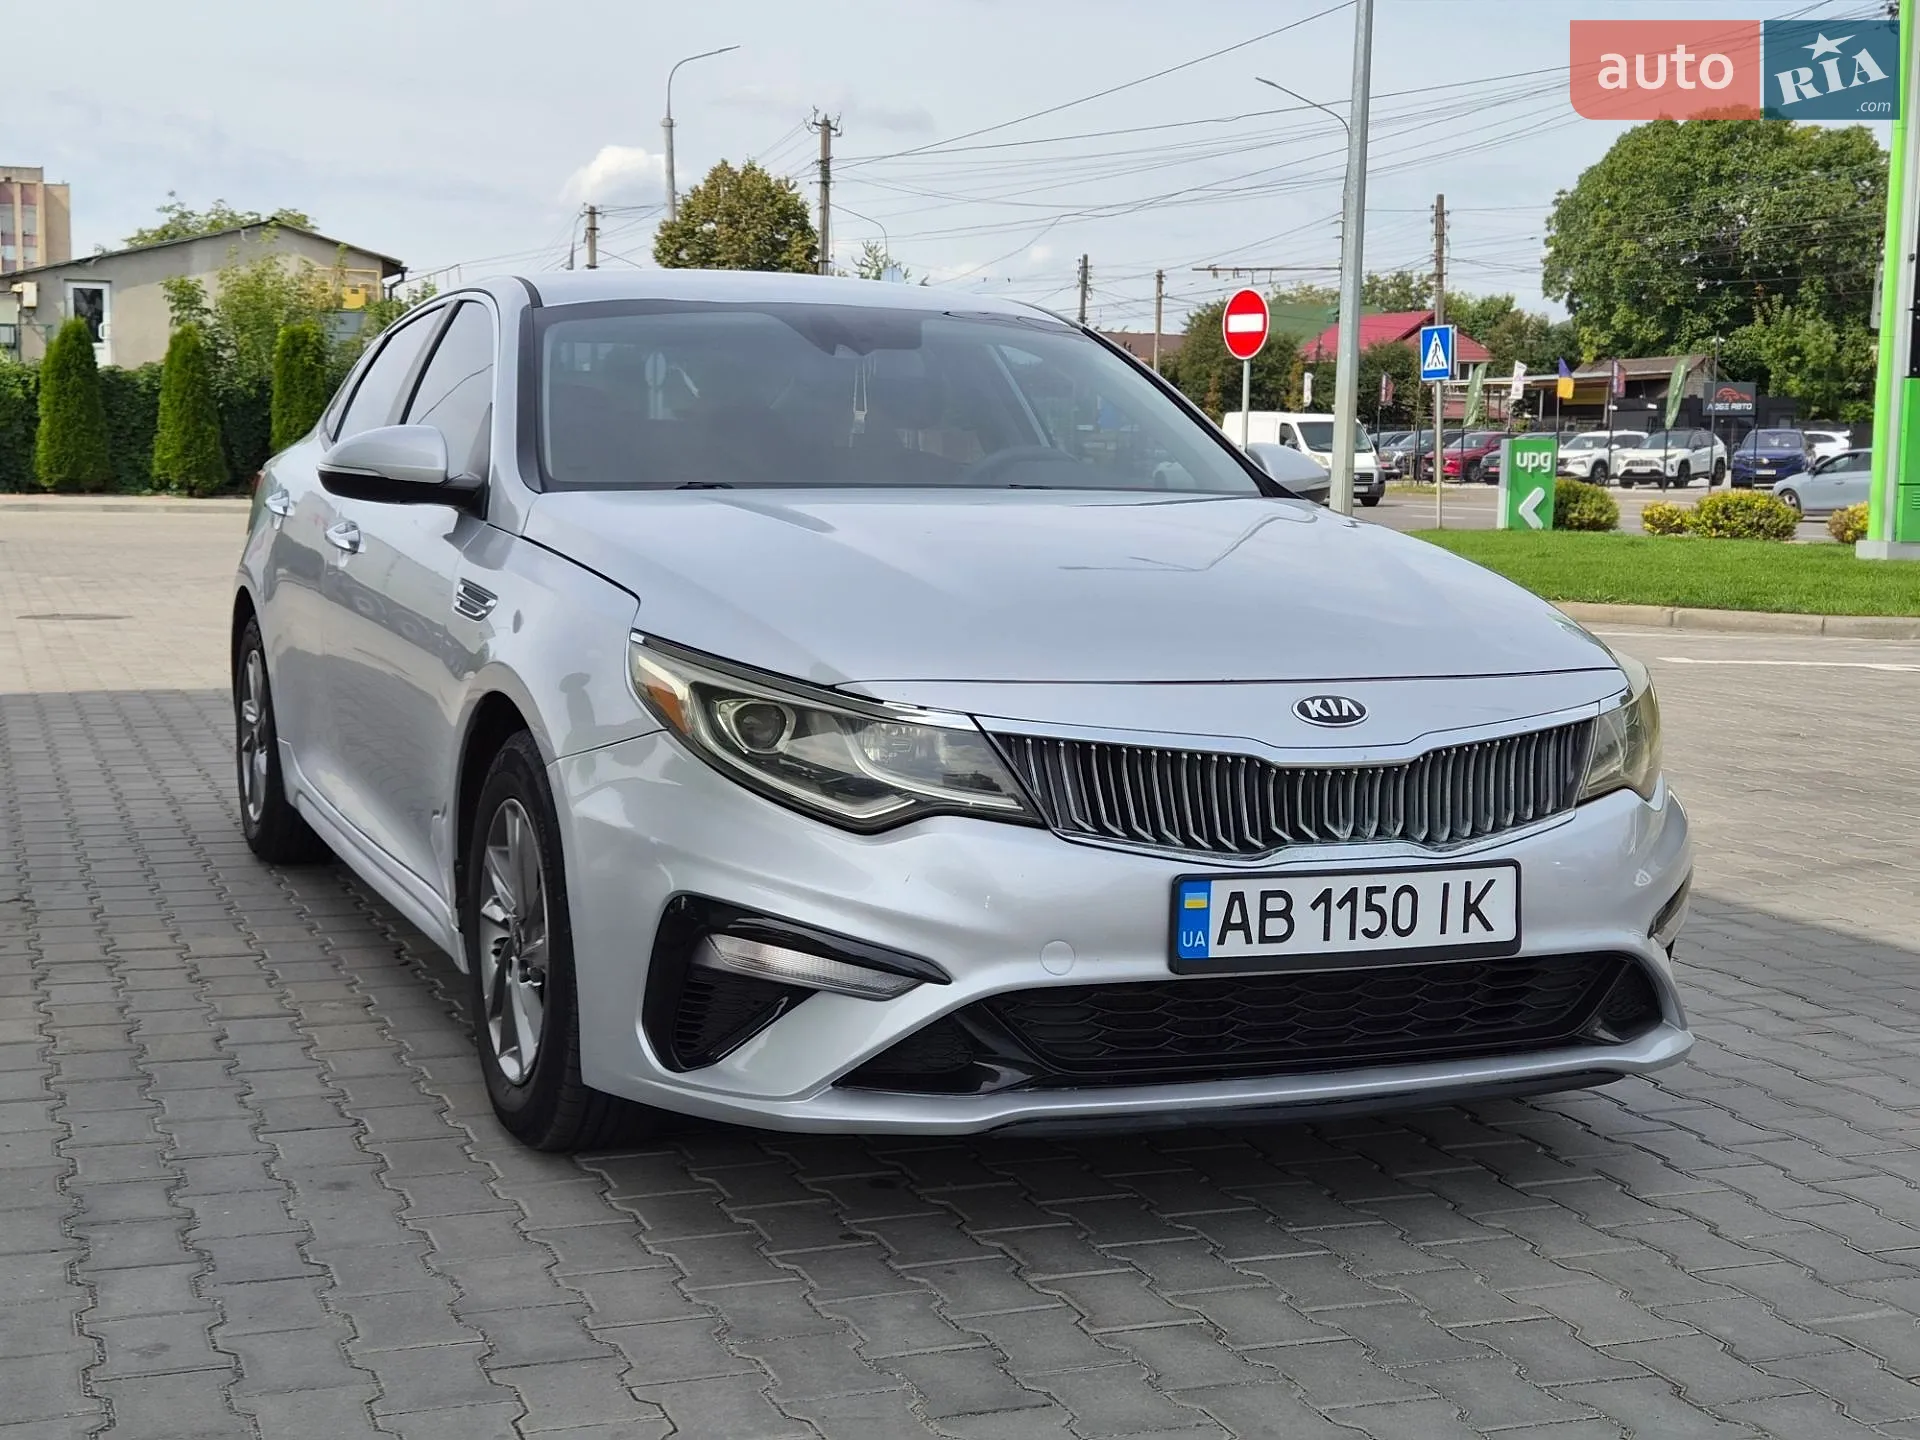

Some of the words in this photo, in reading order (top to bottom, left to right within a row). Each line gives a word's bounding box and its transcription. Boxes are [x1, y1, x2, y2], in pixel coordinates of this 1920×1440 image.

[1516, 451, 1552, 473] upg
[1303, 698, 1361, 718] KIA
[1216, 889, 1295, 945] AB
[1310, 884, 1419, 942] 1150
[1182, 930, 1206, 948] UA
